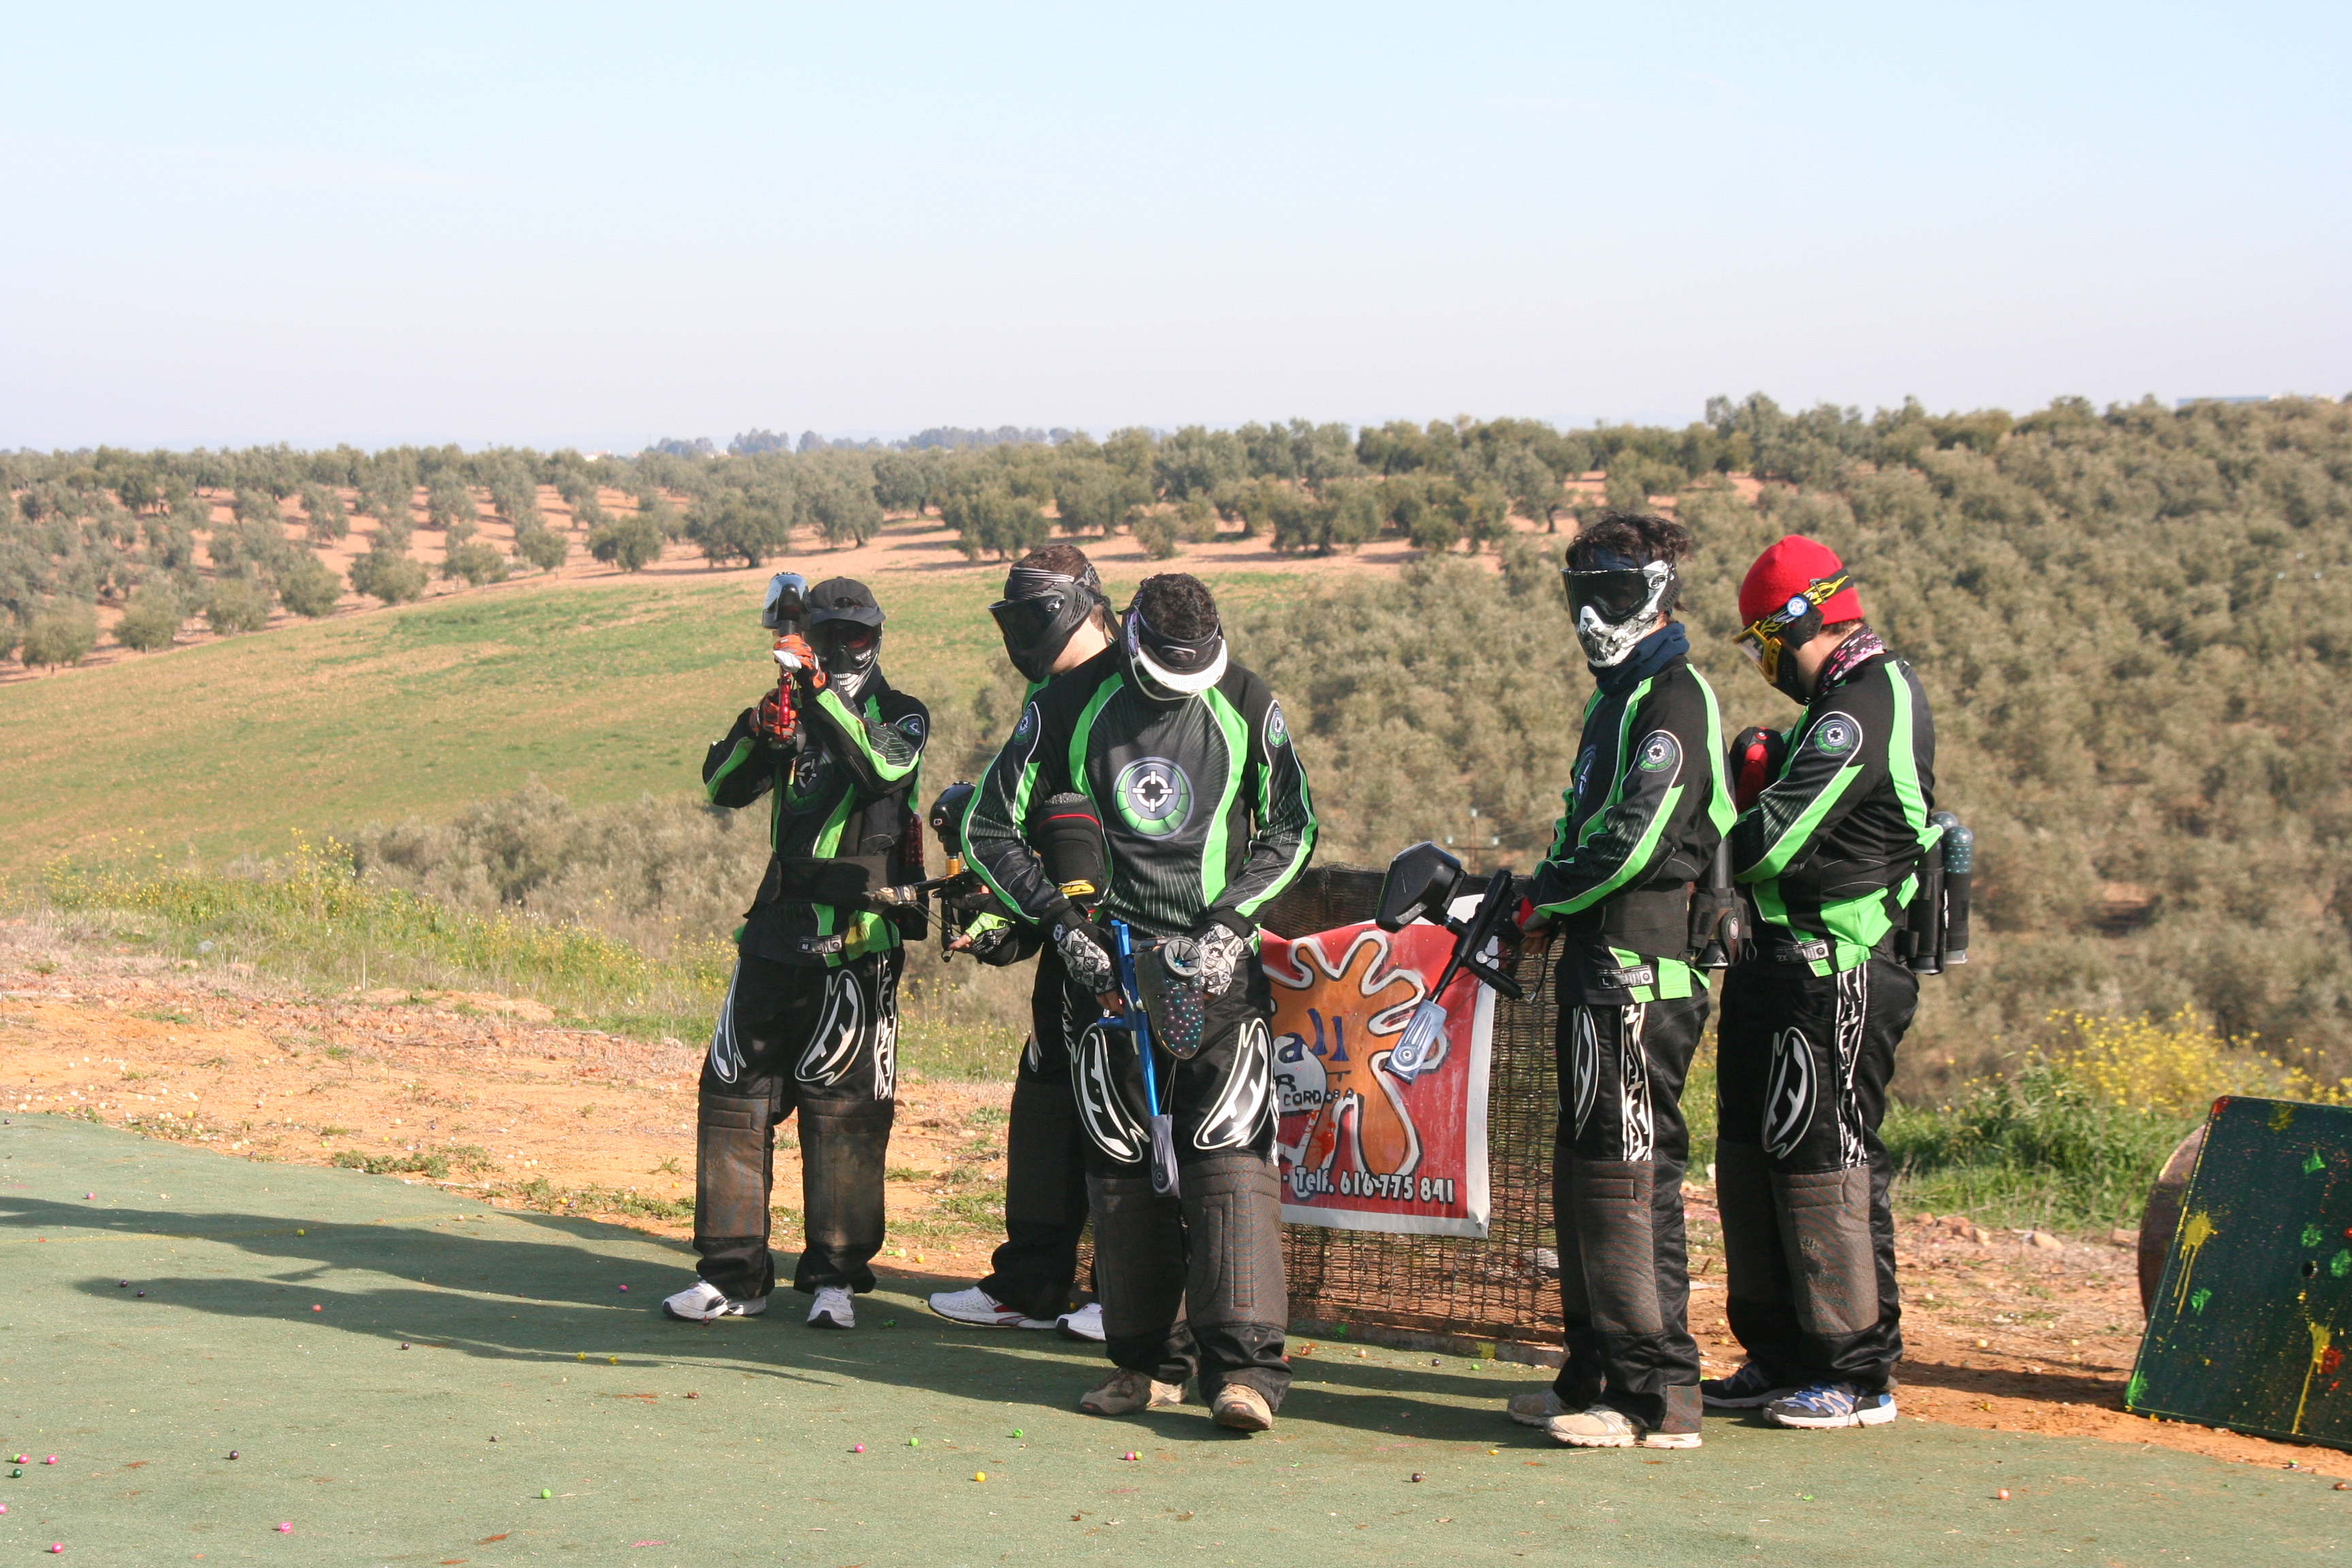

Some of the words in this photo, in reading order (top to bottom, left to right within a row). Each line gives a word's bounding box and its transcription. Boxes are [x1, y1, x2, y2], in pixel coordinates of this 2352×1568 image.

[1276, 1008, 1350, 1064] all
[1284, 1087, 1354, 1107] CORDOBA
[1296, 1166, 1335, 1194] Telf.
[1420, 1177, 1454, 1203] 841
